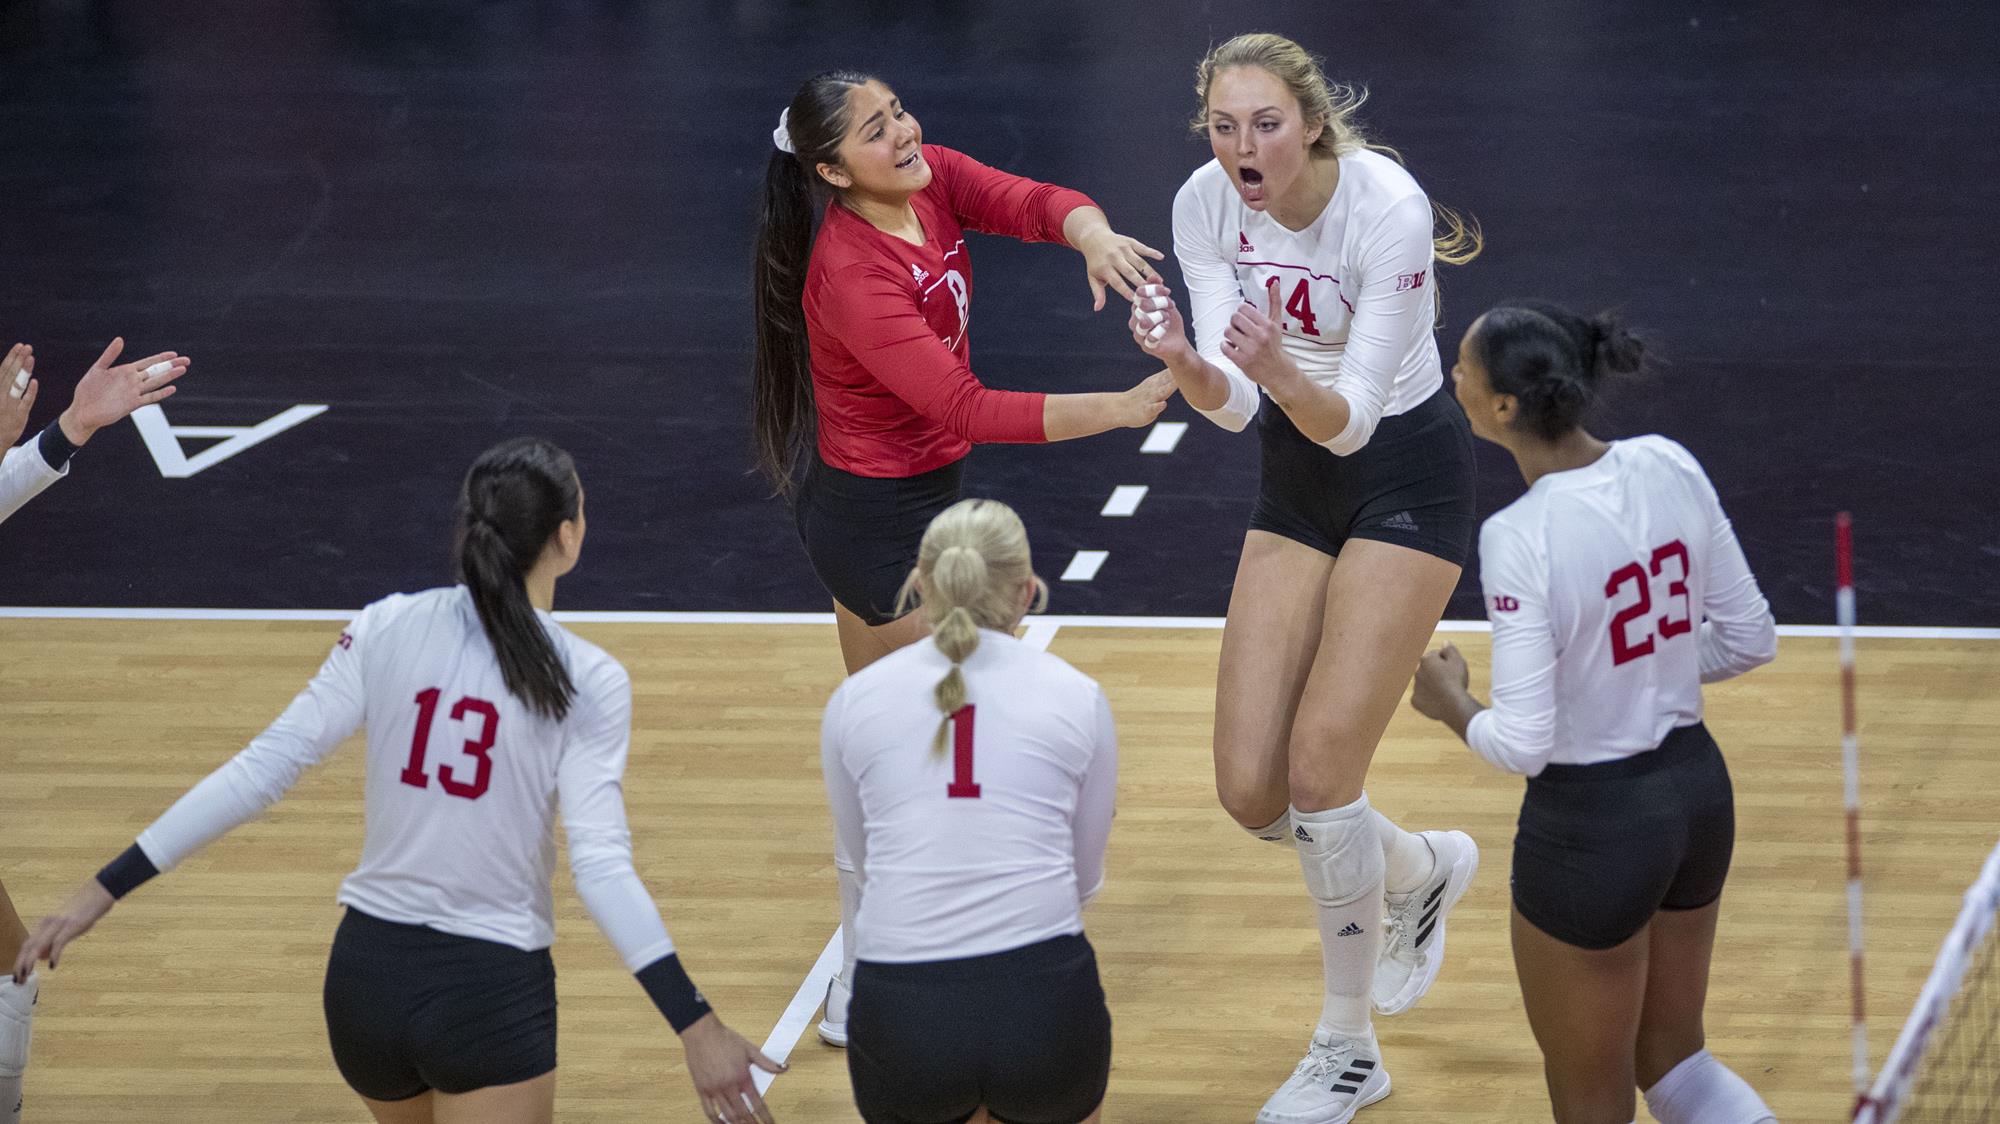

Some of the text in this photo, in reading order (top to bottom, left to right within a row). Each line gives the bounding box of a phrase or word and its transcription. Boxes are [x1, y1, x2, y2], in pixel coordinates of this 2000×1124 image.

[130, 402, 329, 478] A
[1604, 538, 1691, 667] 23
[400, 686, 500, 800] 13
[946, 703, 981, 799] 1
